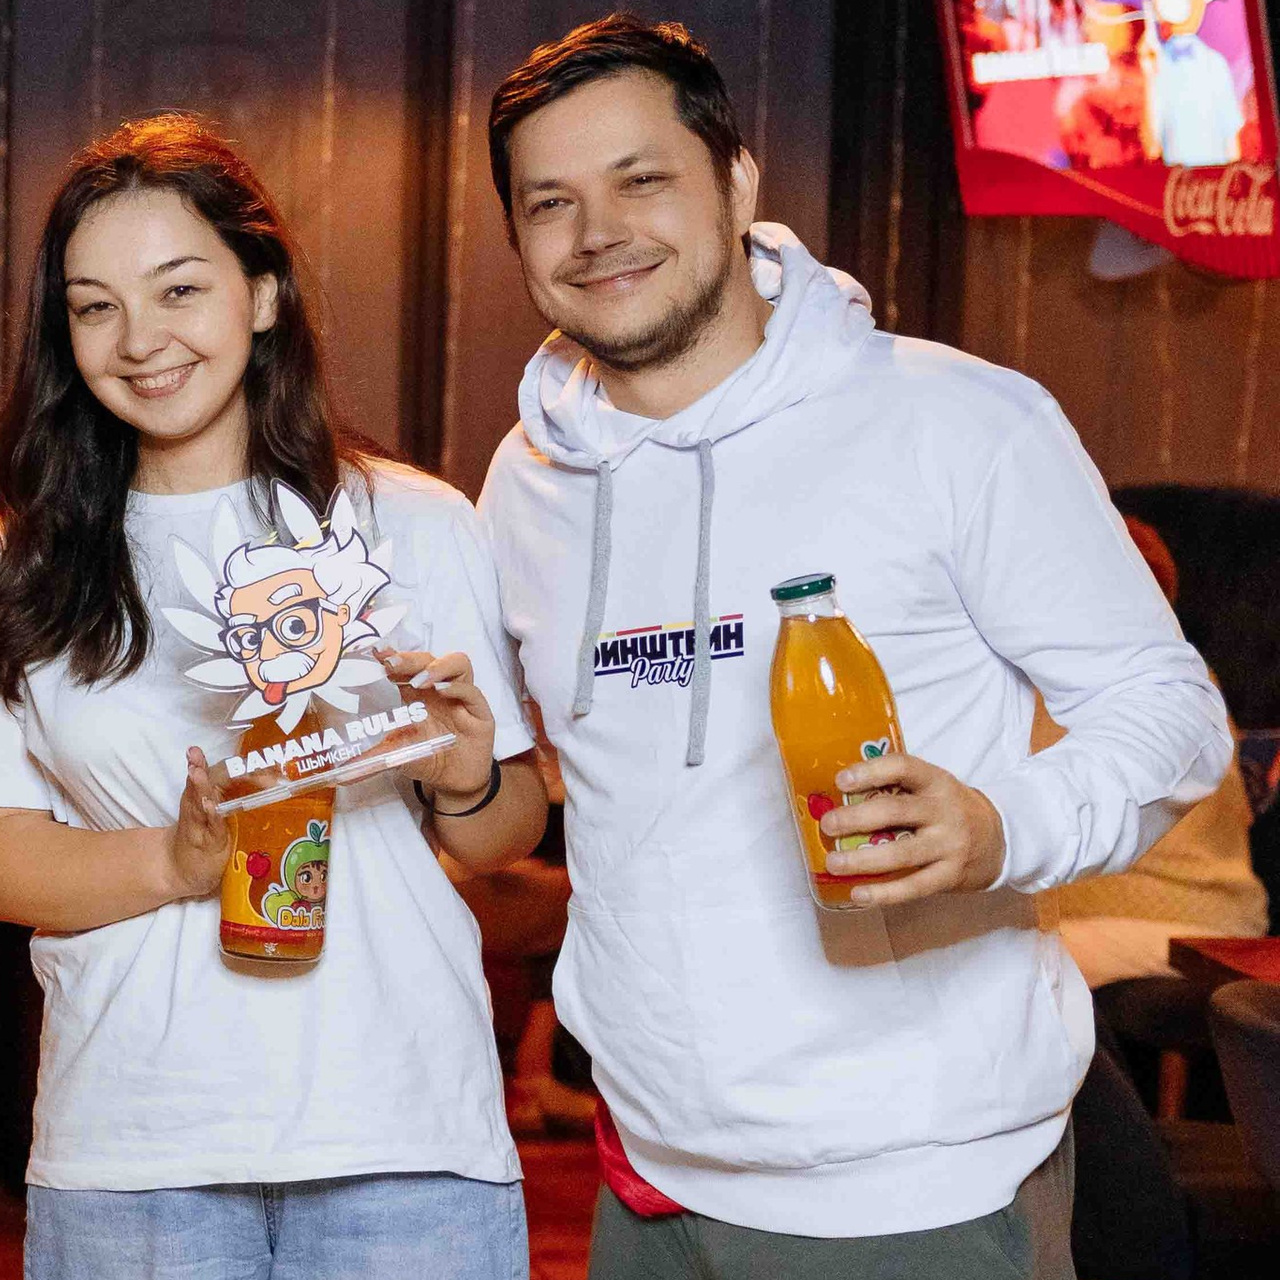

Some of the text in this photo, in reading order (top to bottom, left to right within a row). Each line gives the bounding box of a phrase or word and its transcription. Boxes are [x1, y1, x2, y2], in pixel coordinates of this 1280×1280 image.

[631, 653, 695, 688] Party
[225, 701, 429, 778] BANANA RULES
[295, 743, 363, 774] ШЫМКЕНТ
